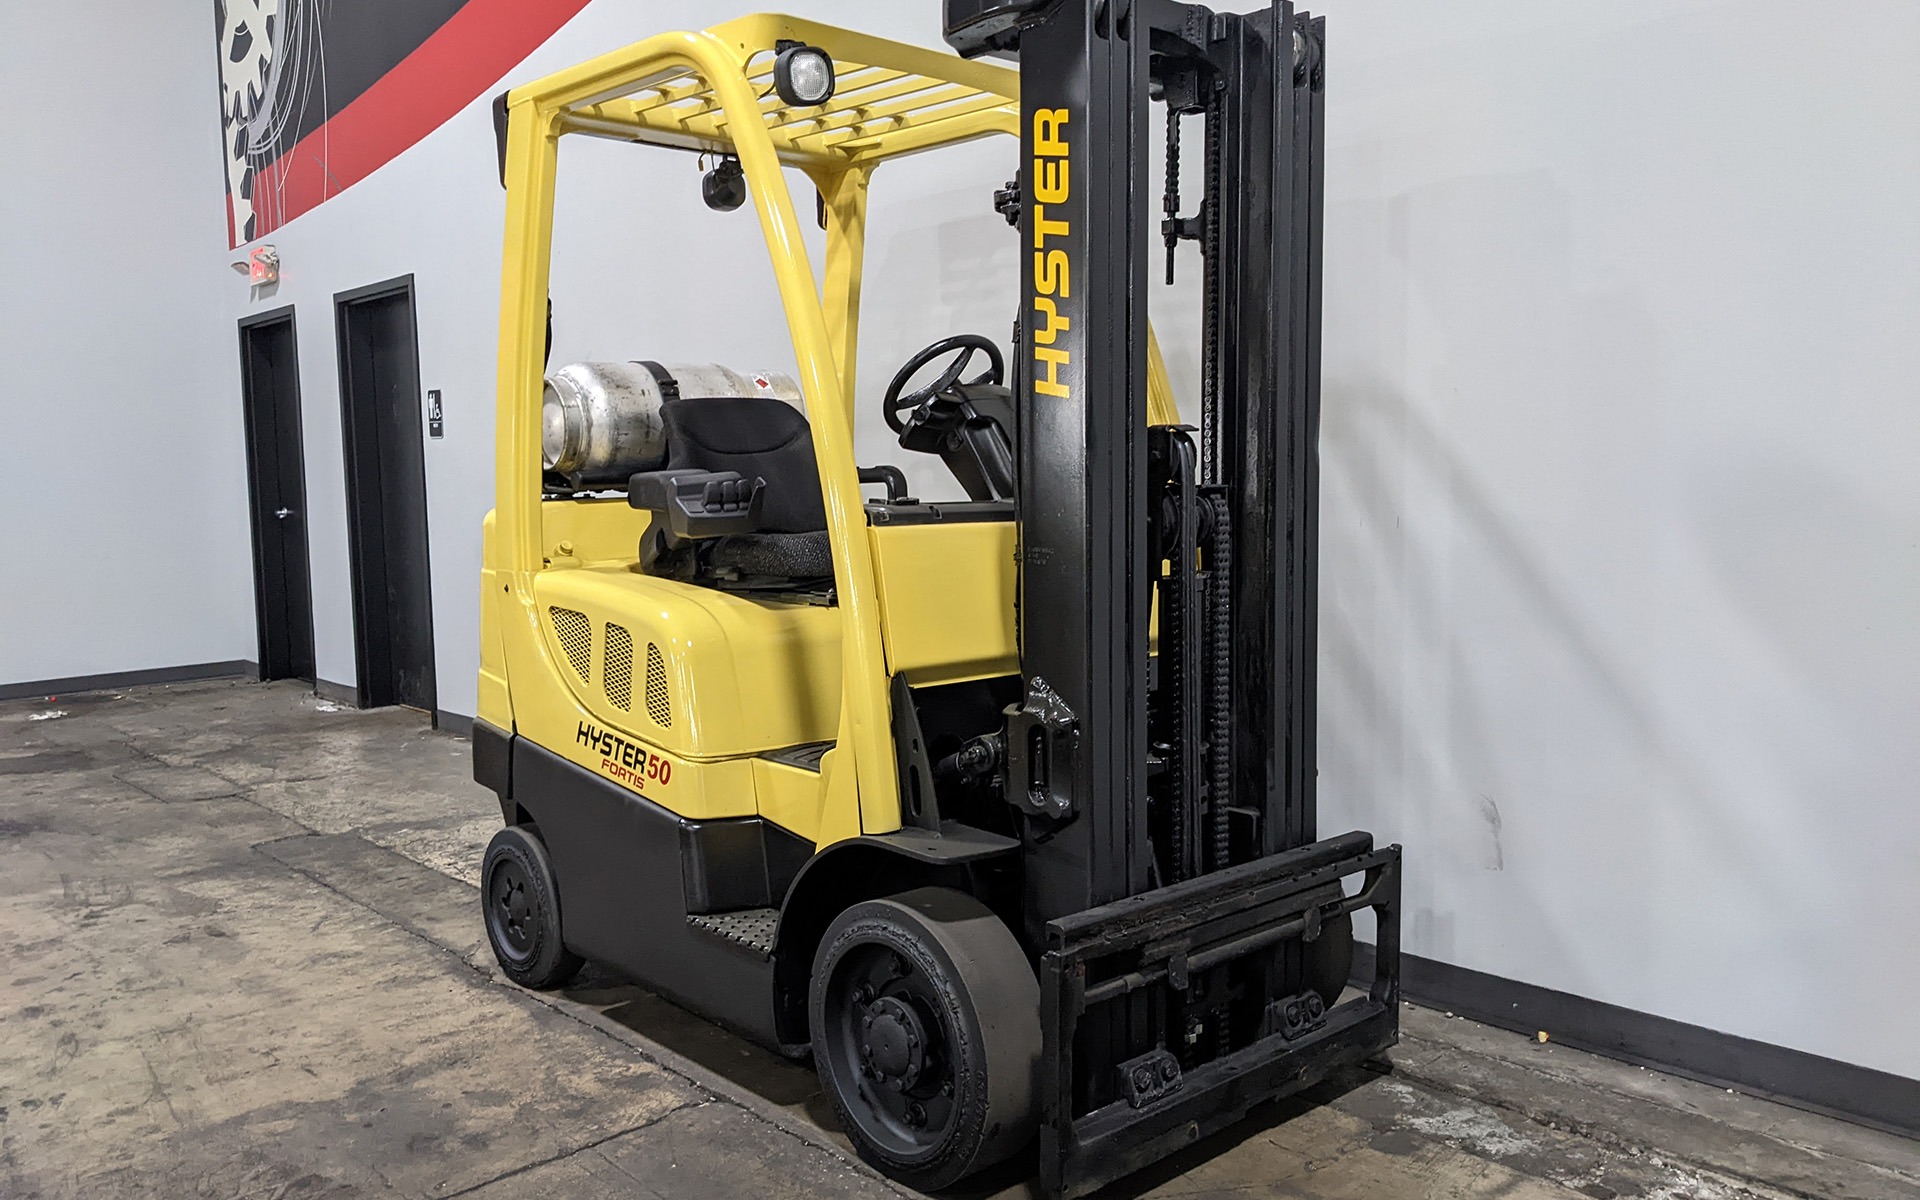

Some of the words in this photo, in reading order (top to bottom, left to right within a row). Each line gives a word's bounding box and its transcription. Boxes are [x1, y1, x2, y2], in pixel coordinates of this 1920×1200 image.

[1033, 108, 1071, 399] HYSTER
[576, 720, 647, 774] HYSTER
[646, 753, 672, 786] 50
[601, 757, 646, 790] FORTIS
